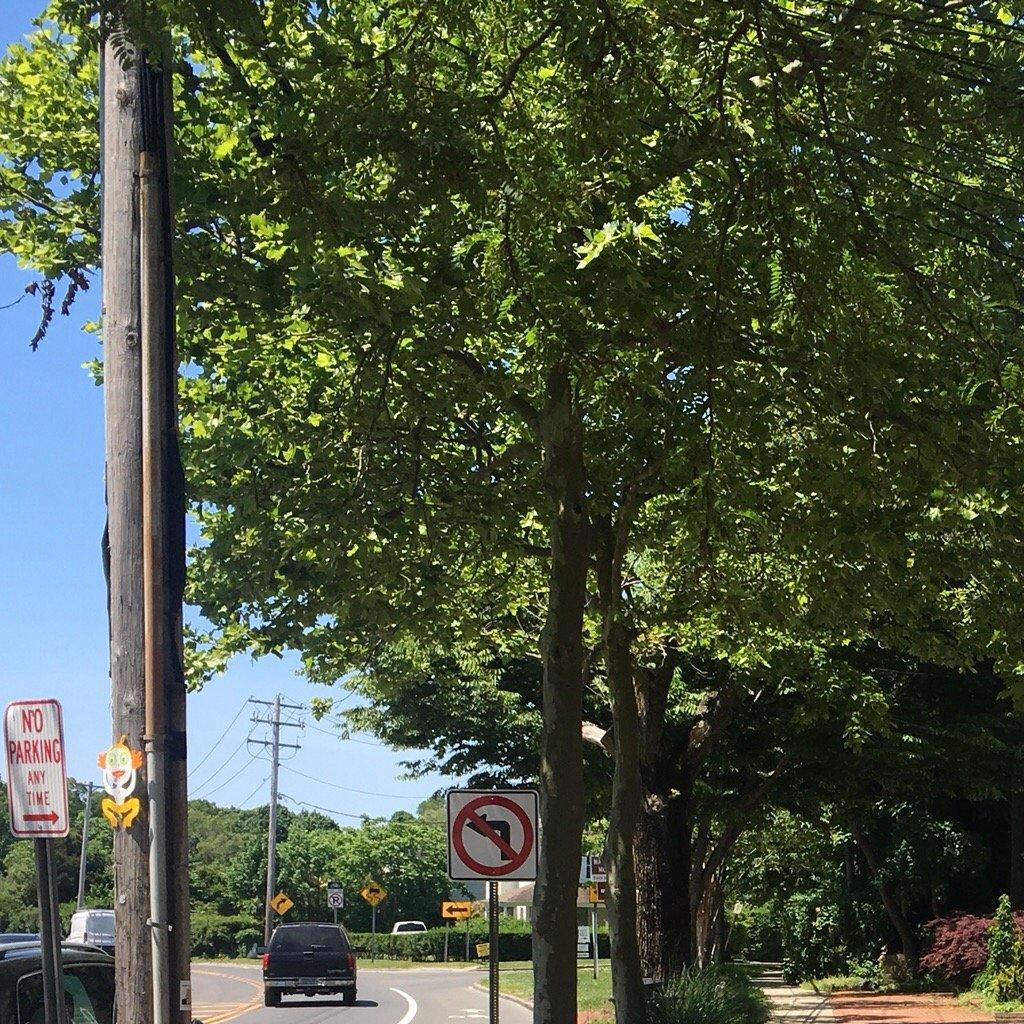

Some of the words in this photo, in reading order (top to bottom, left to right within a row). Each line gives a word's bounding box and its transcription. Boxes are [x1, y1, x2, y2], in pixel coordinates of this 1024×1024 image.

[22, 708, 43, 733] NO
[9, 739, 61, 764] PARKING
[27, 771, 45, 785] ANY
[26, 791, 50, 806] TIME
